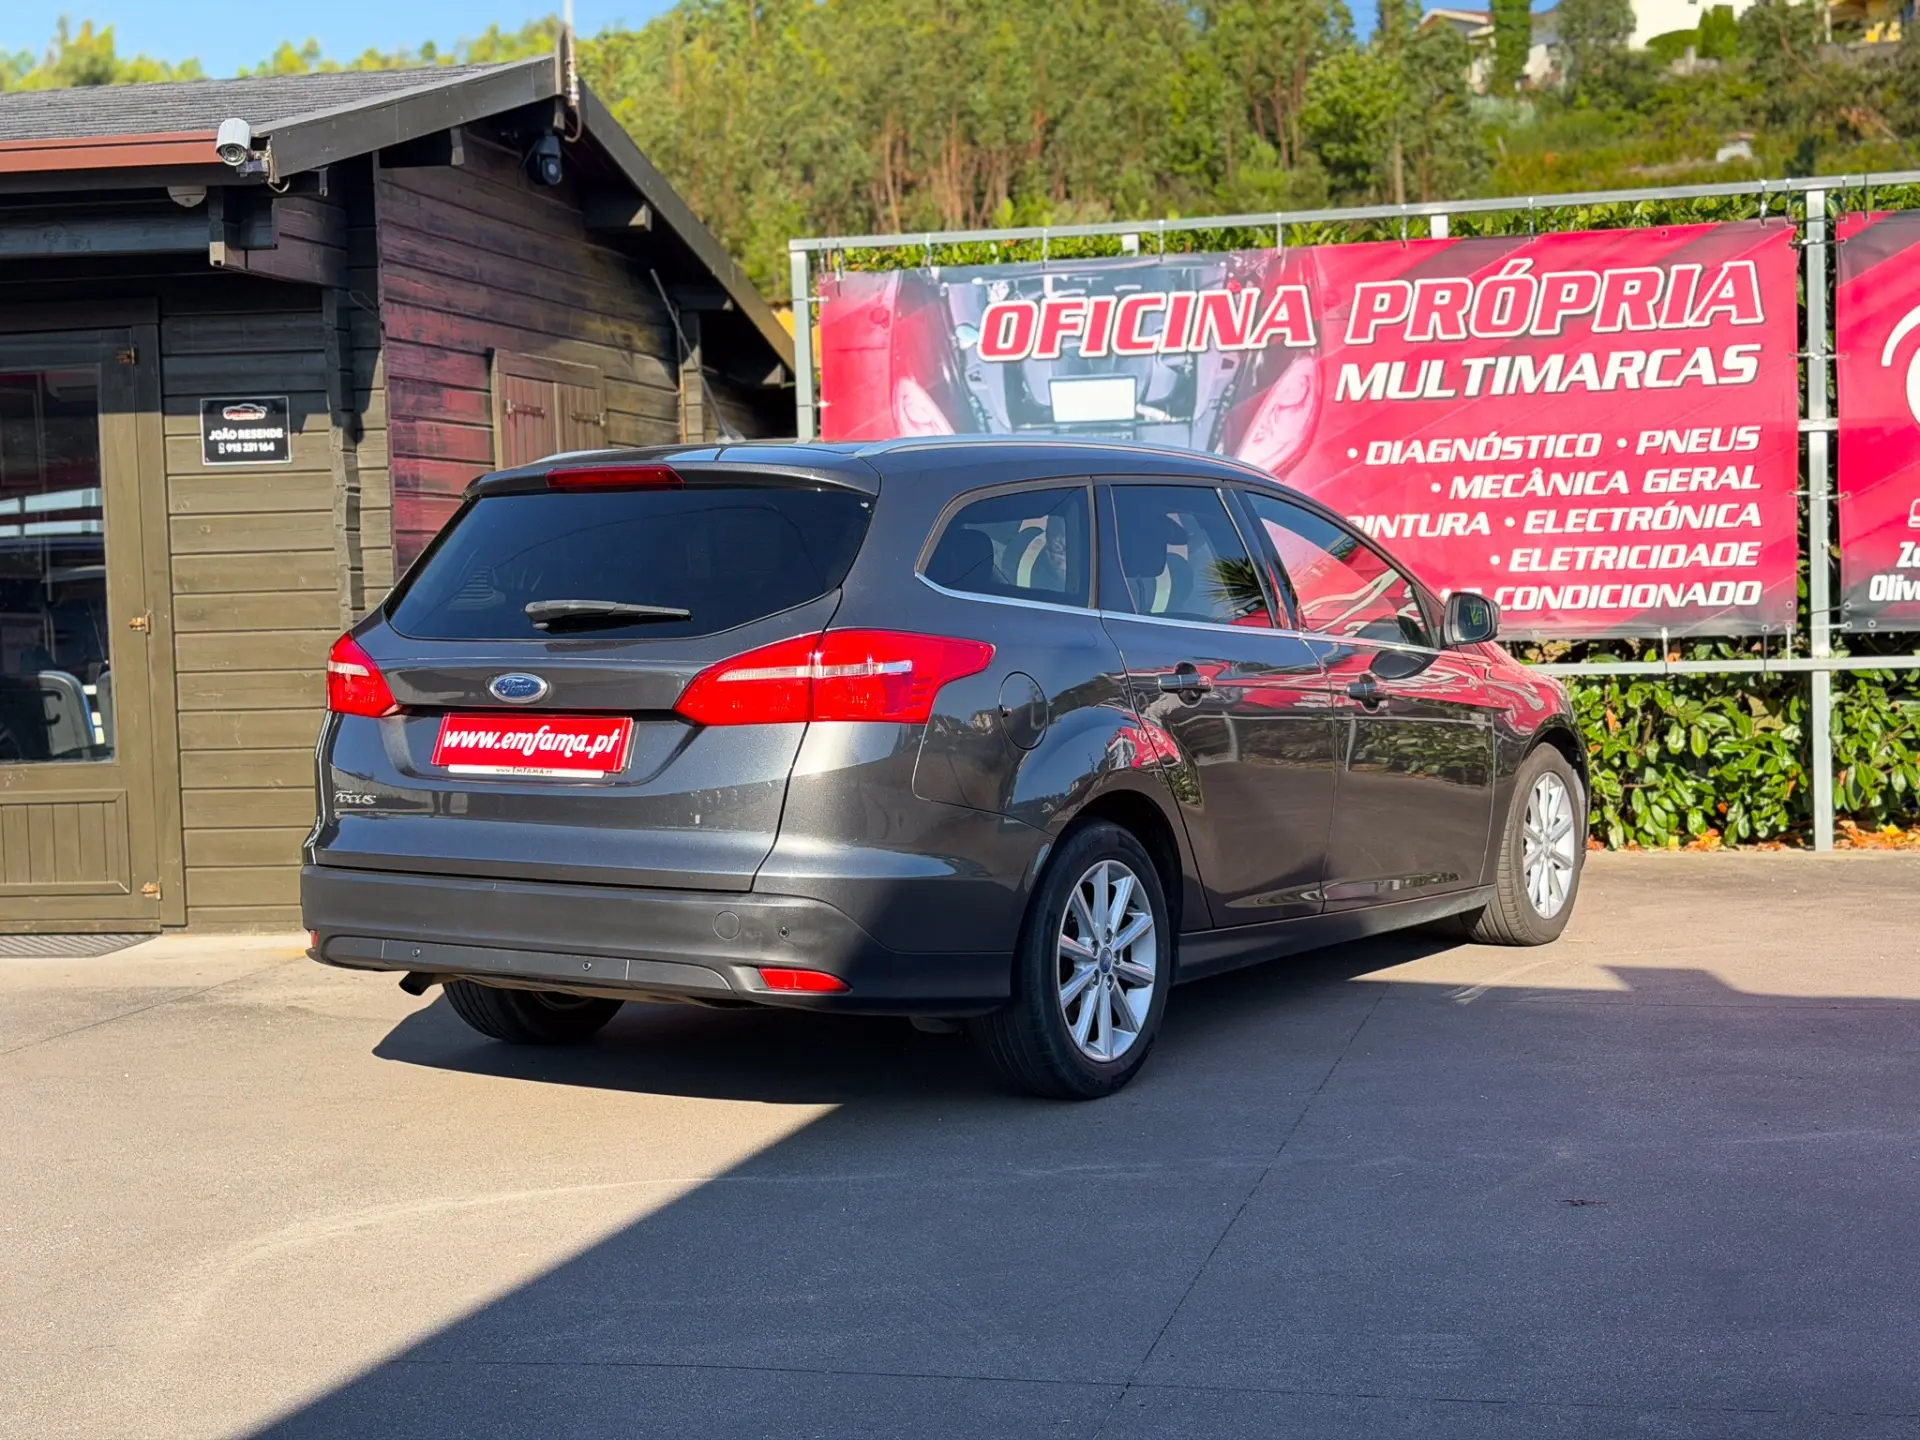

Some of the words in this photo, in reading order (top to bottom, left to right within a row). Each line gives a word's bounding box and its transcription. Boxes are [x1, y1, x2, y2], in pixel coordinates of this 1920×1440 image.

[977, 285, 1317, 362] OFICINA
[1344, 258, 1765, 345] PRÓPRIA
[1335, 344, 1762, 402] MULTIMARCAS
[209, 428, 237, 440] JOÃO
[238, 428, 283, 438] RESENDE
[226, 443, 242, 453] 915
[258, 441, 275, 452] 164
[1365, 431, 1603, 466] DIAGNÓSTICO
[1635, 425, 1762, 456] PNEUS
[1449, 467, 1630, 501] MECÂNICA
[1642, 465, 1762, 494] GERAL
[1522, 500, 1762, 535] ELECTRÓNICA
[1507, 541, 1762, 573] ELETRICIDADE
[1494, 580, 1763, 612] CONDICIONADO
[443, 725, 620, 759] www.emfama.pt
